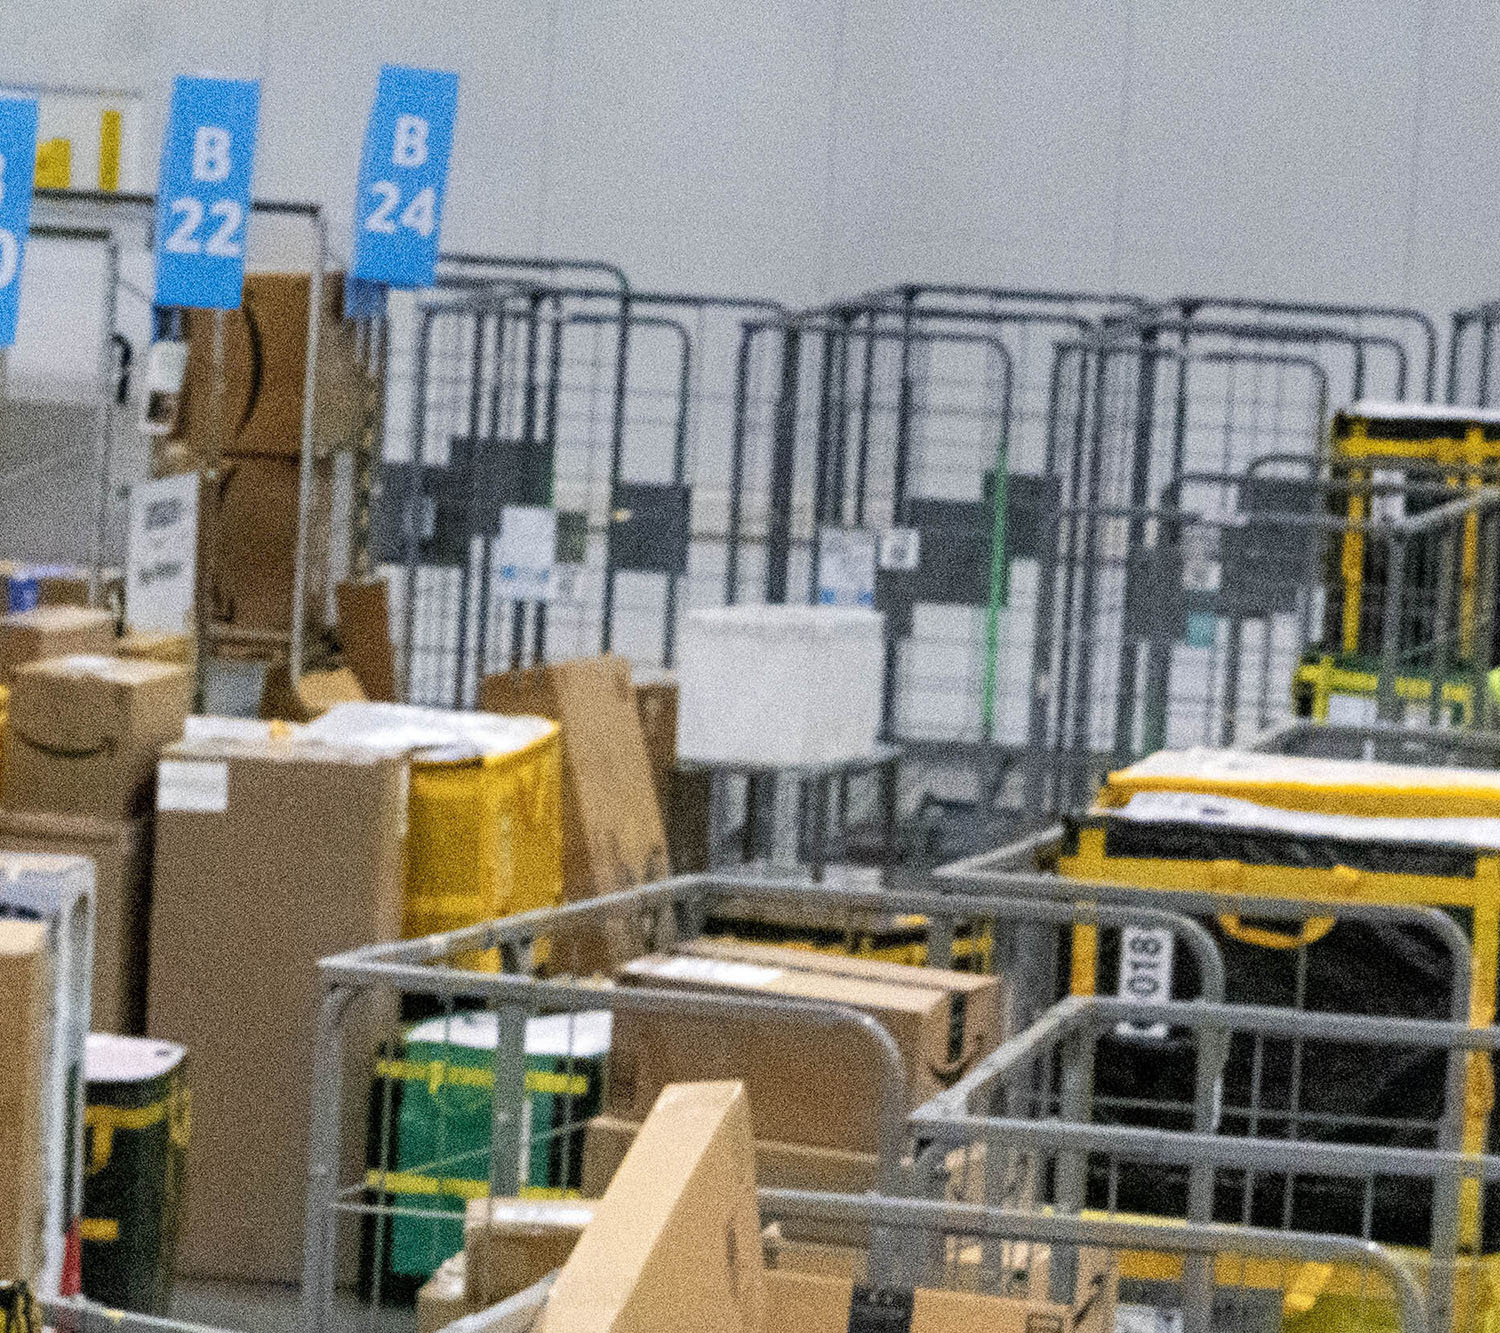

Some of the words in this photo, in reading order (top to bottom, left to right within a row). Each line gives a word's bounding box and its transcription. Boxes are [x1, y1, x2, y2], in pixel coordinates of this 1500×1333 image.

[193, 126, 231, 182] B
[392, 114, 428, 167] B
[166, 197, 244, 255] 22
[366, 182, 437, 237] 24
[1126, 936, 1162, 998] 018
